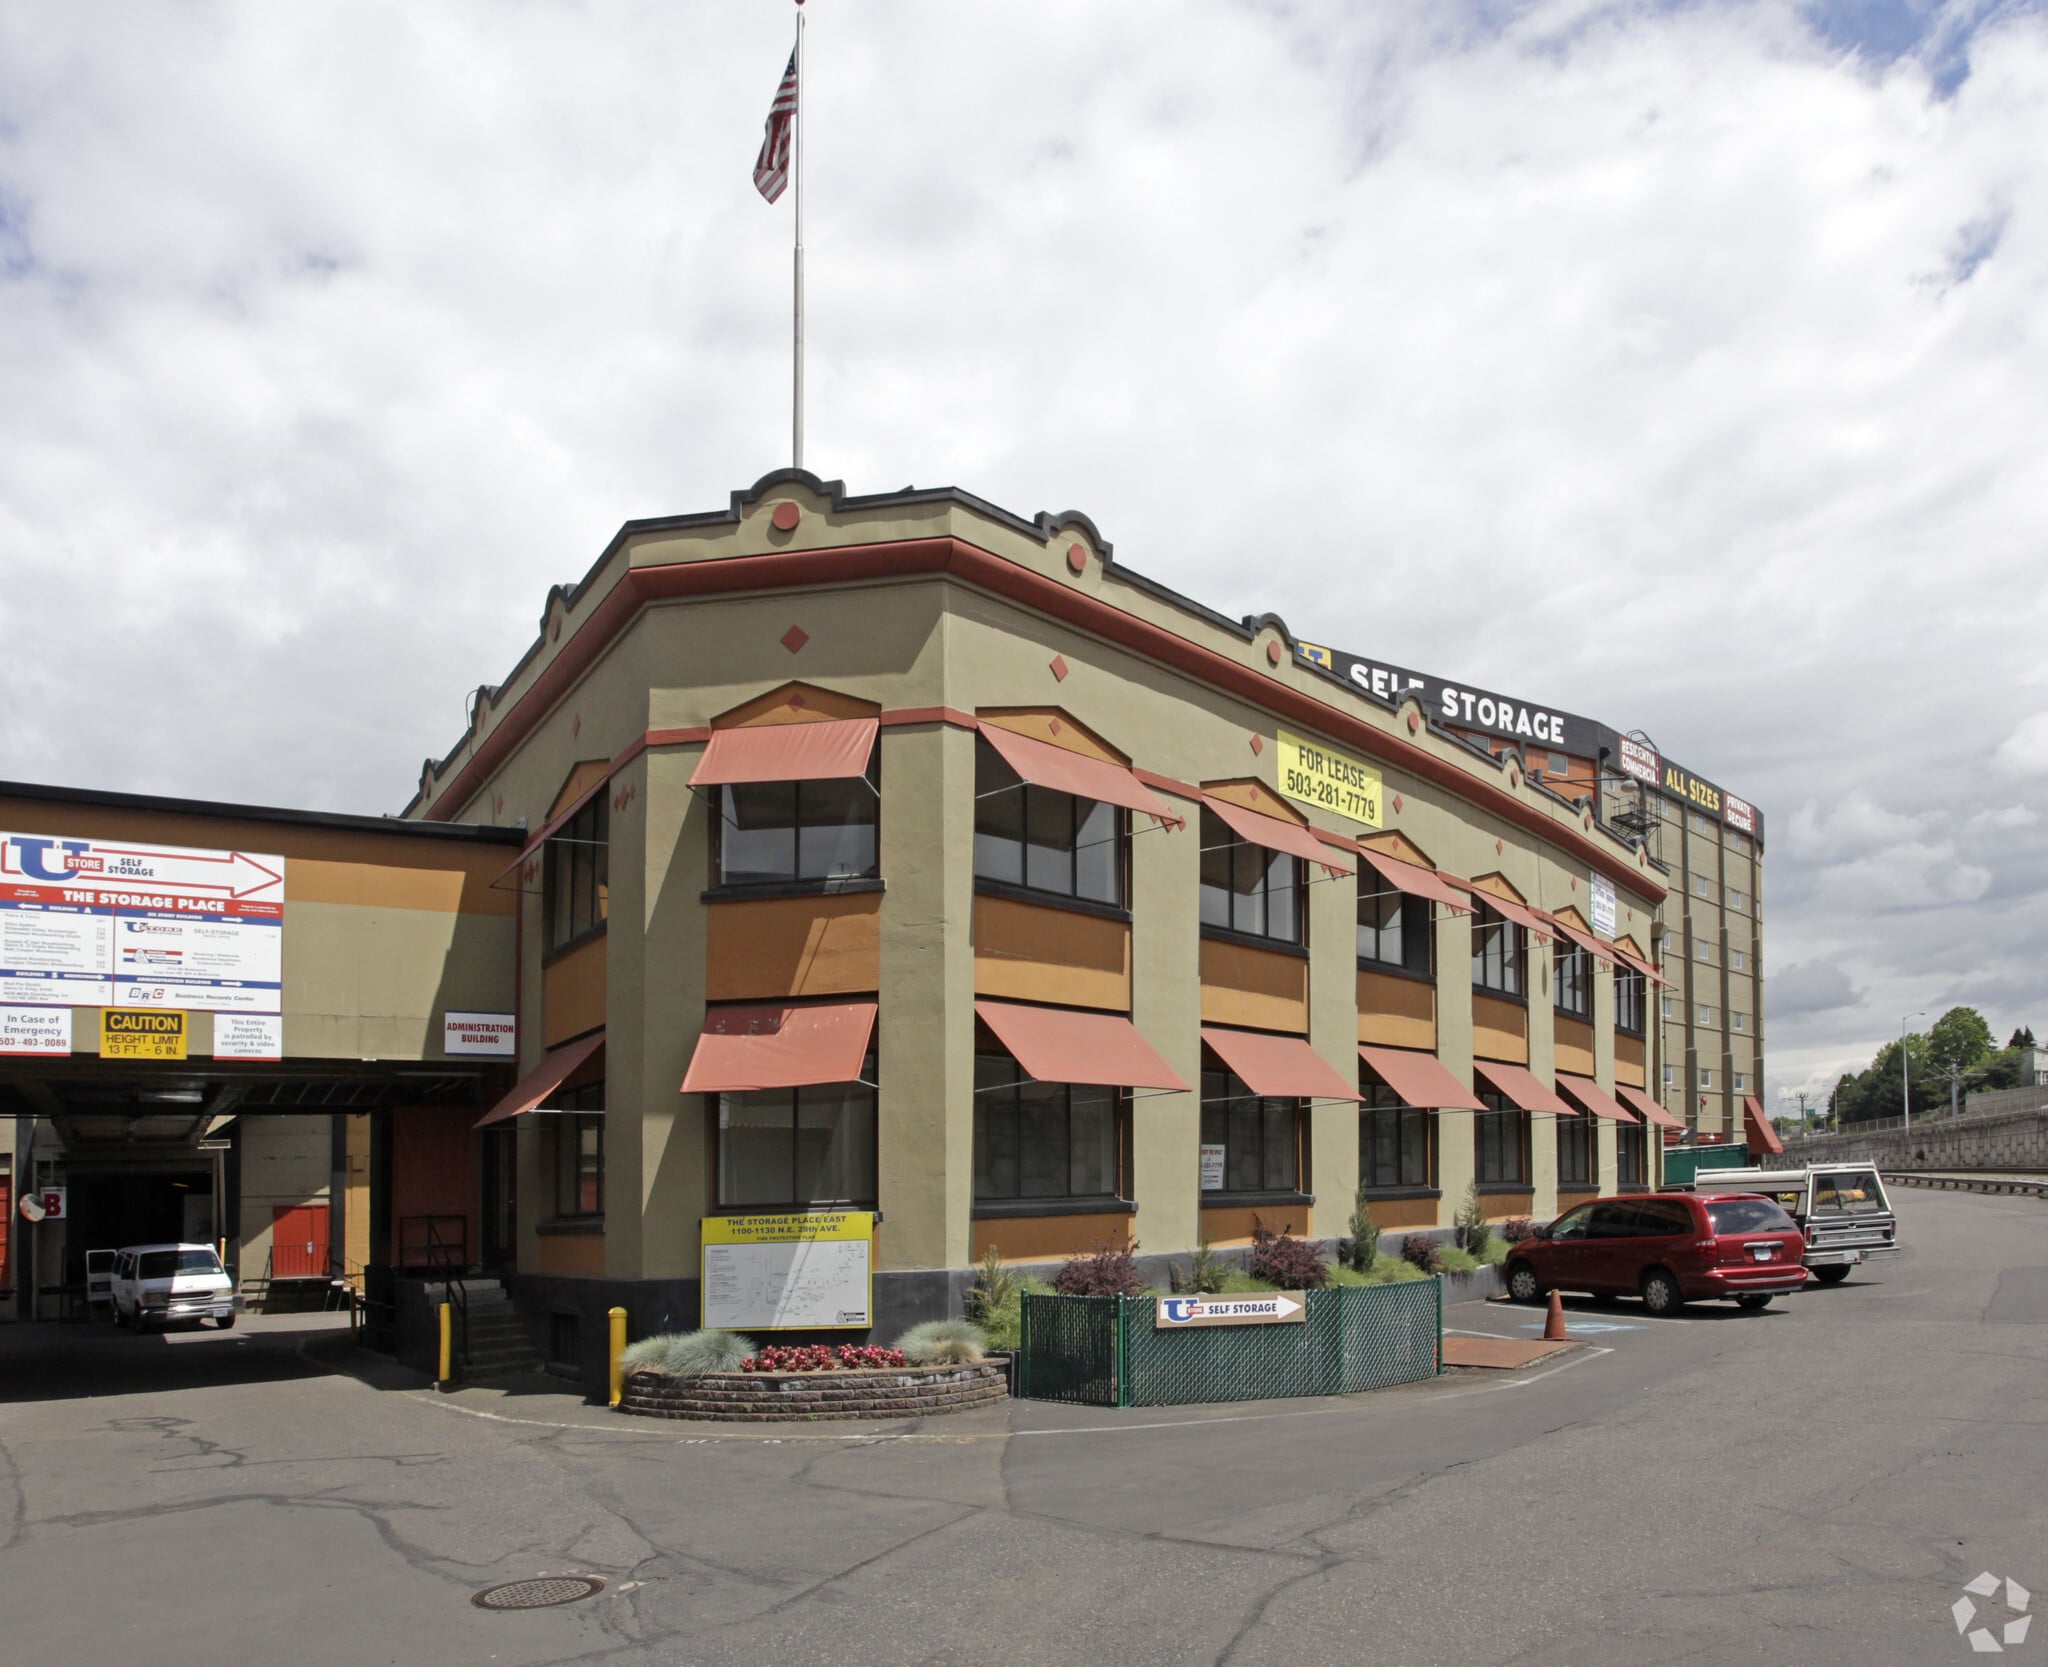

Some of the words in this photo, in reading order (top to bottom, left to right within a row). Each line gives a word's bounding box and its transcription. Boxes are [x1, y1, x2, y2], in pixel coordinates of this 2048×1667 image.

[1441, 687, 1565, 744] STORAGE
[1298, 744, 1324, 775] FOR
[1327, 752, 1365, 790] LEASE
[1287, 768, 1375, 820] 503-281-7779
[1666, 767, 1687, 796] ALL
[1689, 778, 1720, 811] SIZES
[1726, 795, 1752, 818] PRIVATE
[1727, 809, 1752, 832] SECURE
[67, 858, 101, 869] STORE
[120, 857, 143, 867] SELF
[108, 866, 154, 877] STORAGE
[63, 890, 94, 903] THE
[99, 893, 173, 908] STORAGE
[178, 898, 225, 912] PLACE
[84, 906, 92, 914] A
[7, 1014, 17, 1023] In
[21, 1015, 45, 1024] Case
[48, 1016, 59, 1024] of
[110, 1014, 178, 1031] CAUTION
[4, 1025, 62, 1037] Emergency
[234, 1026, 263, 1034] Property
[447, 1022, 514, 1033] ADMINISTRATION
[106, 1034, 148, 1044] HEIGHT
[152, 1035, 180, 1045] LIMIT
[461, 1034, 499, 1044] BUILDING
[108, 1045, 120, 1054] 13
[124, 1046, 141, 1055] FT.
[154, 1046, 162, 1055] 6
[166, 1047, 179, 1056] IN.
[45, 1193, 61, 1217] B
[748, 1217, 789, 1225] STORAGE
[792, 1216, 820, 1224] PLACE
[824, 1215, 847, 1223] EAST
[731, 1227, 775, 1235] 1100-1130
[820, 1224, 840, 1232] AVE.
[1163, 1299, 1198, 1322] U
[1208, 1304, 1230, 1314] SELF
[1233, 1303, 1277, 1314] STORAGE
